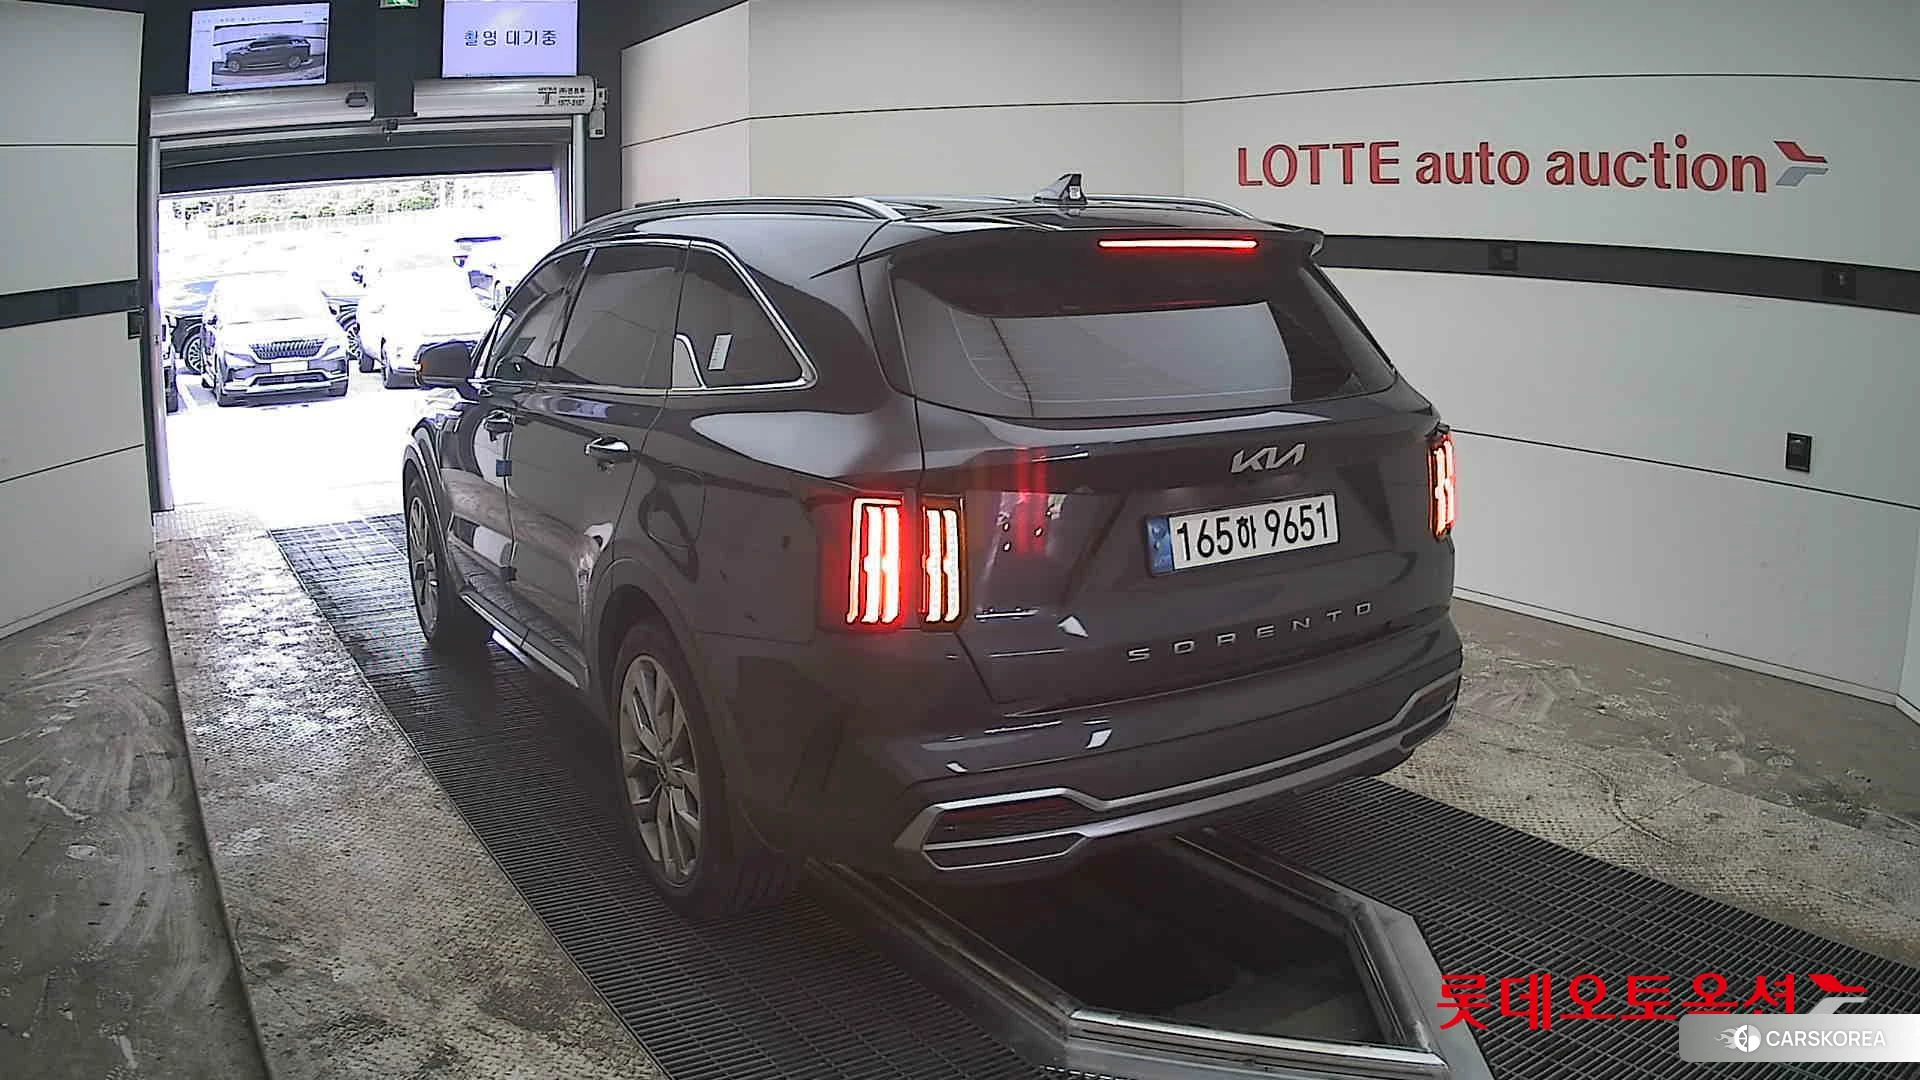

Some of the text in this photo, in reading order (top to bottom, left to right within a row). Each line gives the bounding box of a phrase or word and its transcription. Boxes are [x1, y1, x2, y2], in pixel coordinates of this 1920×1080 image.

[505, 30, 557, 46] 대기중
[1238, 134, 1767, 193] LOTTE auto auction
[1231, 443, 1305, 473] KIA
[1176, 502, 1329, 561] 165하 9651
[1127, 602, 1372, 662] SORENTO
